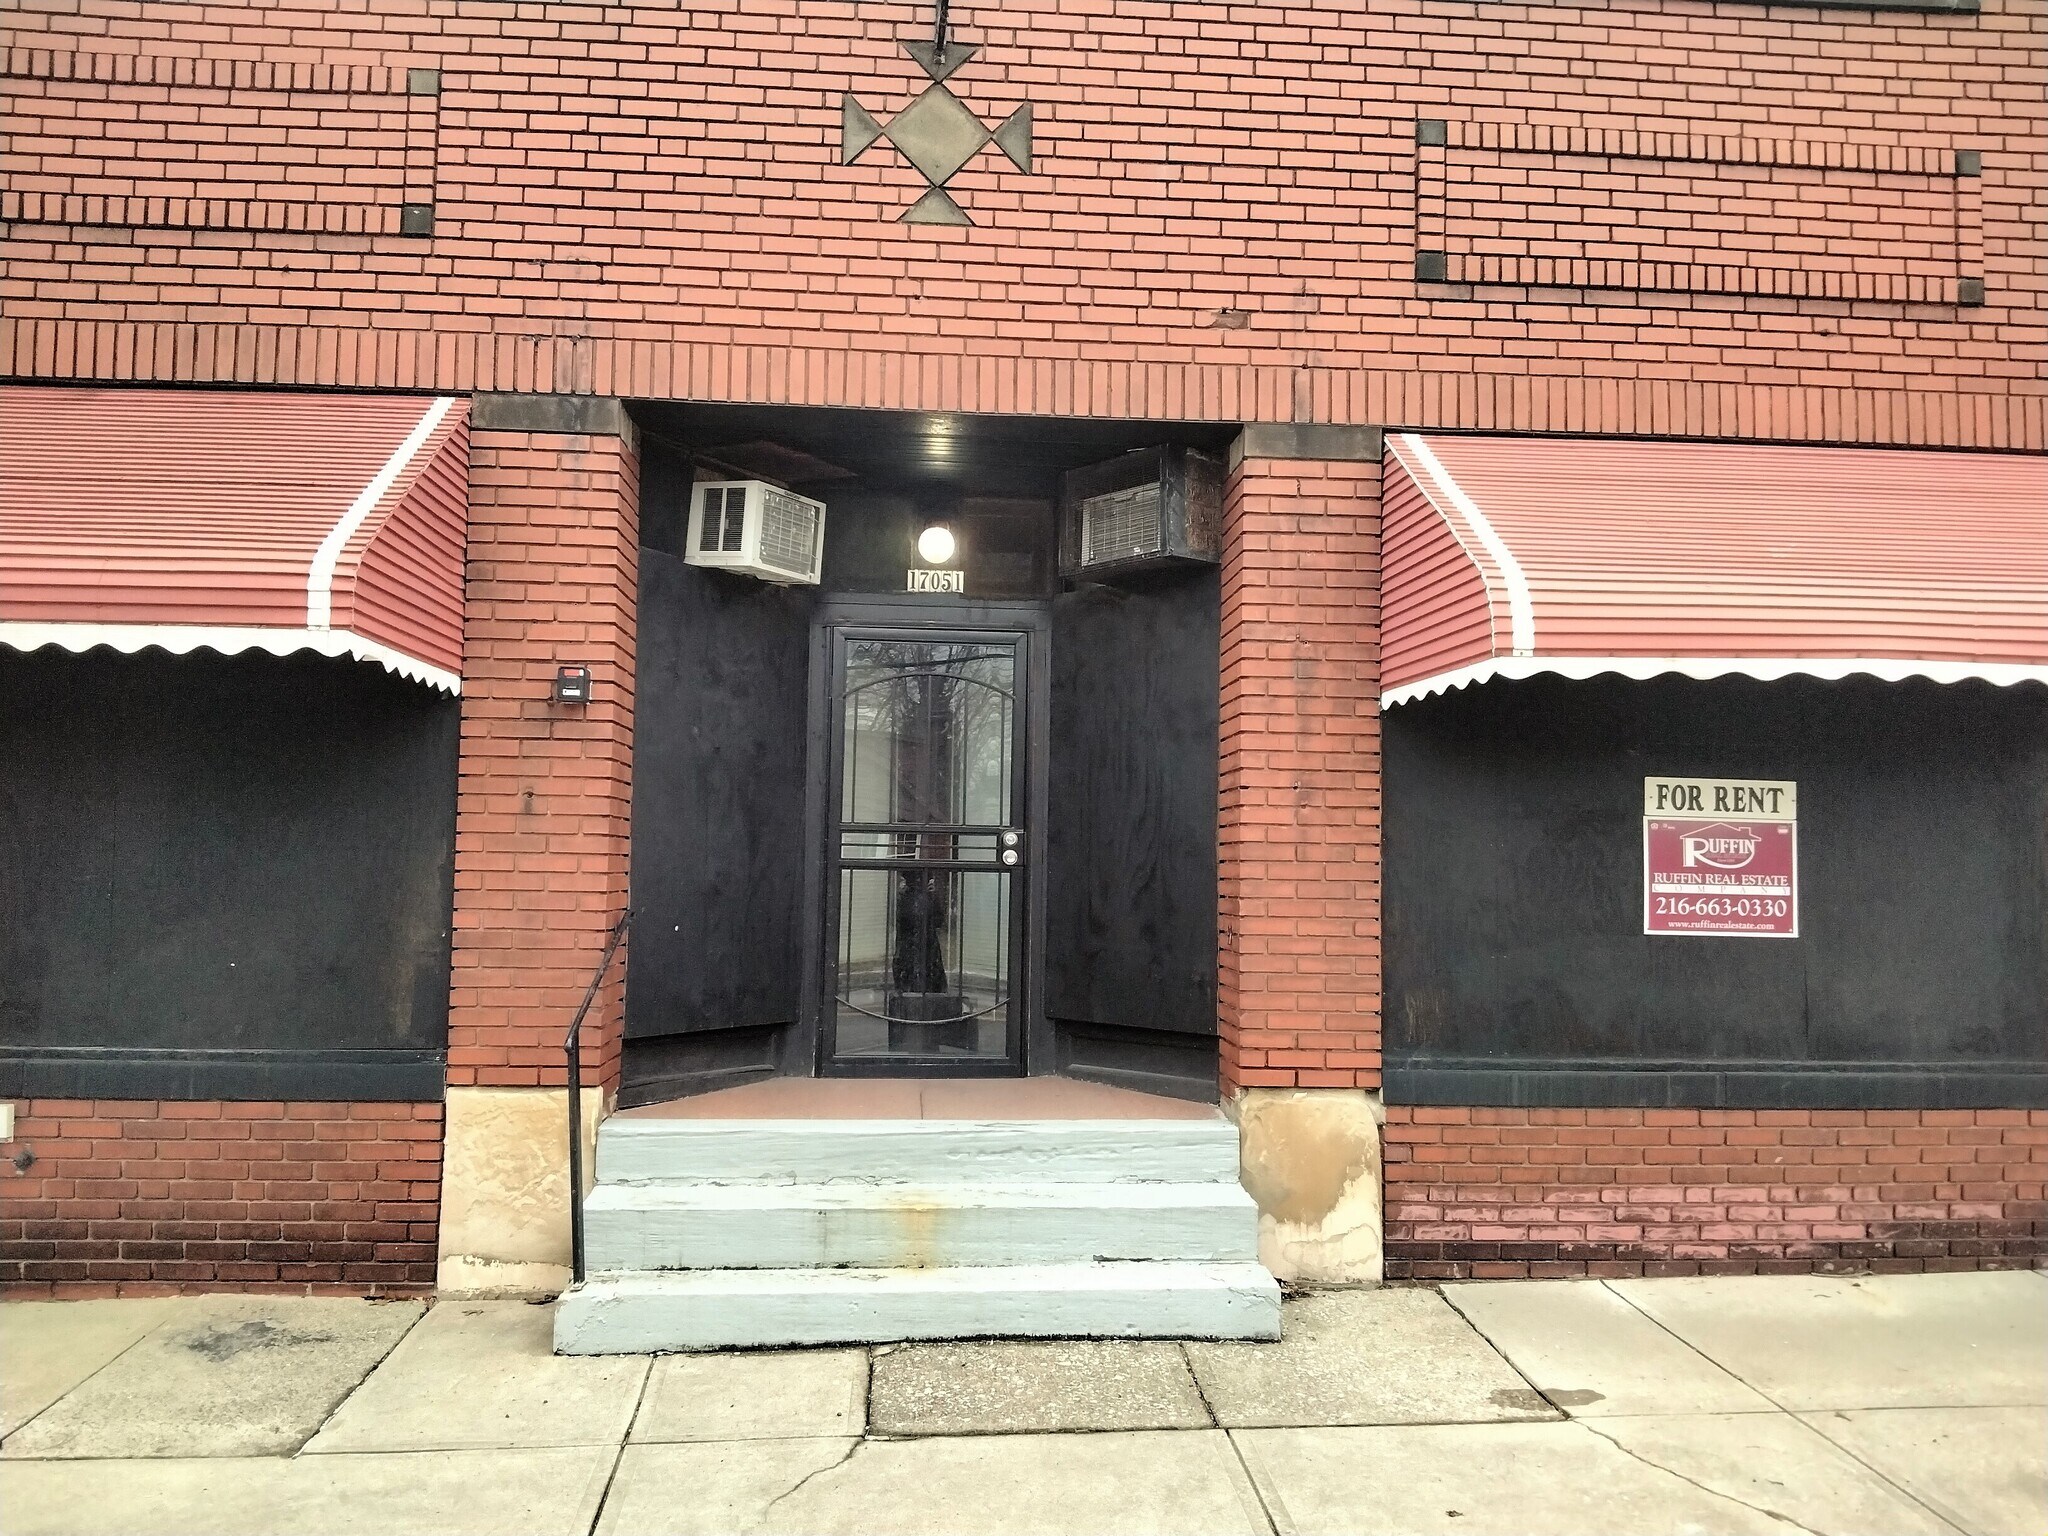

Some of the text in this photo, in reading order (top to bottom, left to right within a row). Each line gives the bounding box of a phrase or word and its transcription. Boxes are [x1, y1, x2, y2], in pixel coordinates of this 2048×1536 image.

[909, 571, 961, 591] 17051
[1655, 784, 1784, 813] FOR RENT
[1653, 872, 1789, 886] RUFFIN REAL ESTATE
[1655, 897, 1787, 917] 216-663-0330
[1668, 919, 1775, 930] www.ruffinrealestate.com
